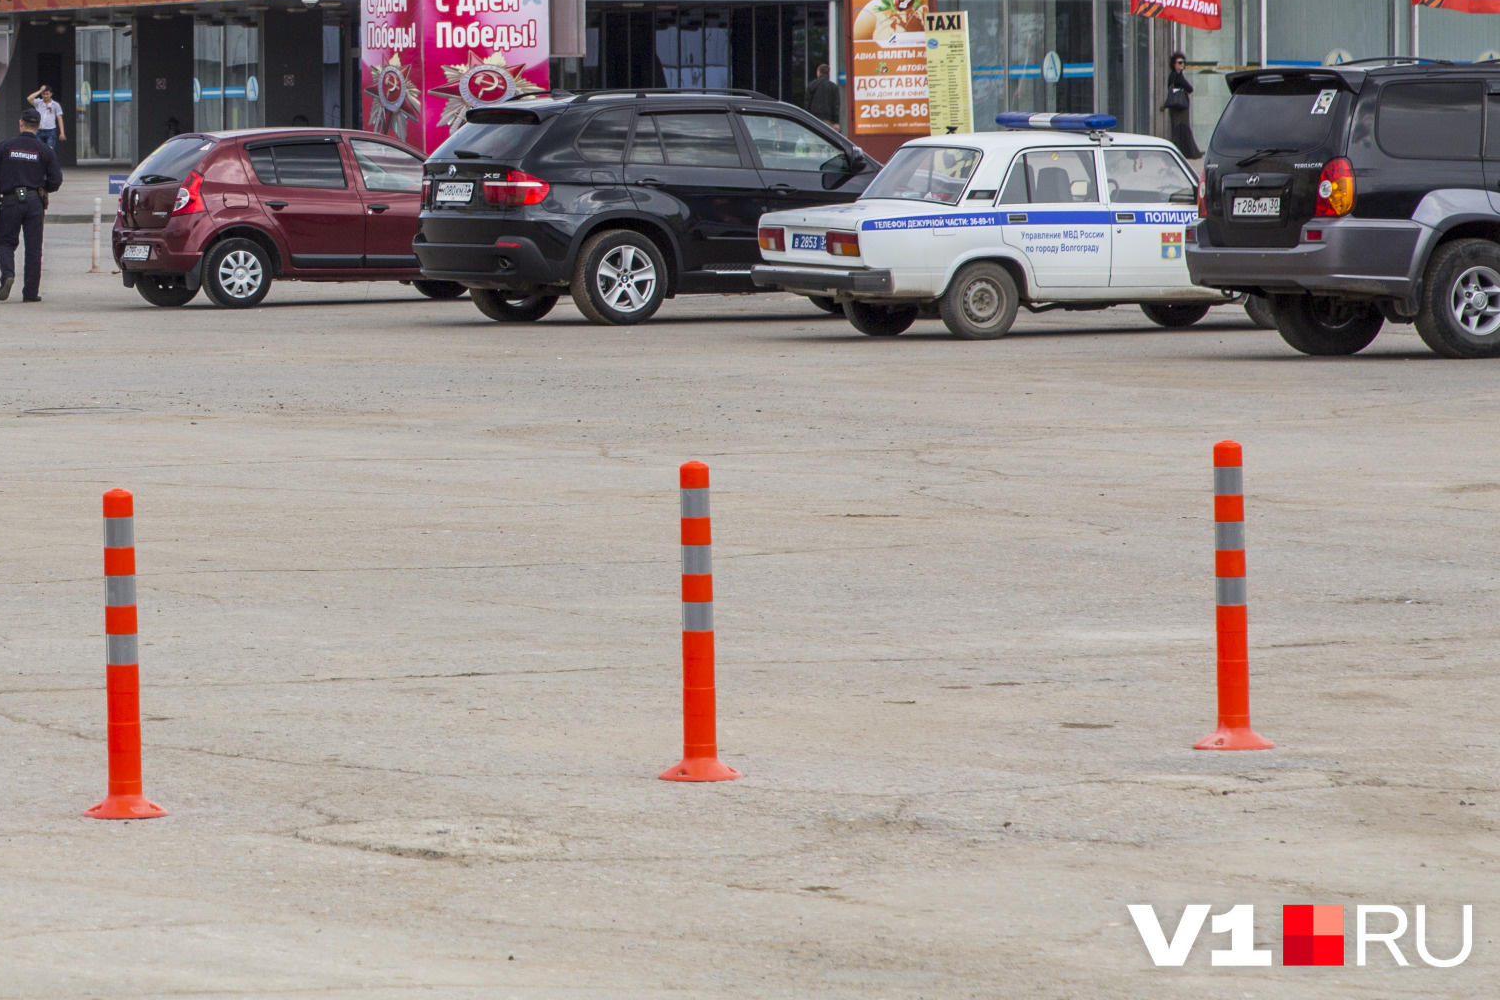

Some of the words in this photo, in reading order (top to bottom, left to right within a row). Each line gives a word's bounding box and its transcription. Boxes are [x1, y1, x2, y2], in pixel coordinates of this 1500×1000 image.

[927, 15, 961, 31] TAXI
[367, 21, 416, 51] Победы!
[436, 20, 536, 51] Победы!
[877, 50, 915, 59] БИЛЕТЫ
[896, 64, 927, 72] АВТОБУ
[856, 77, 928, 91] ДОСТАВКА
[860, 103, 928, 118] 26-86-86
[11, 151, 38, 160] ПОЛИЦИЯ
[874, 220, 906, 229] ТЕЛЕФОН
[908, 217, 945, 228] ДЕЖУРНОЙ
[945, 217, 969, 226] ЧАСТИ:
[1145, 212, 1199, 224] ПОЛИЦИЯ
[801, 235, 818, 248] 2853
[1021, 231, 1061, 241] Управление
[1063, 230, 1078, 240] МВД
[1080, 230, 1104, 239] России
[1035, 245, 1059, 254] городу
[1061, 243, 1100, 254] Волгограду
